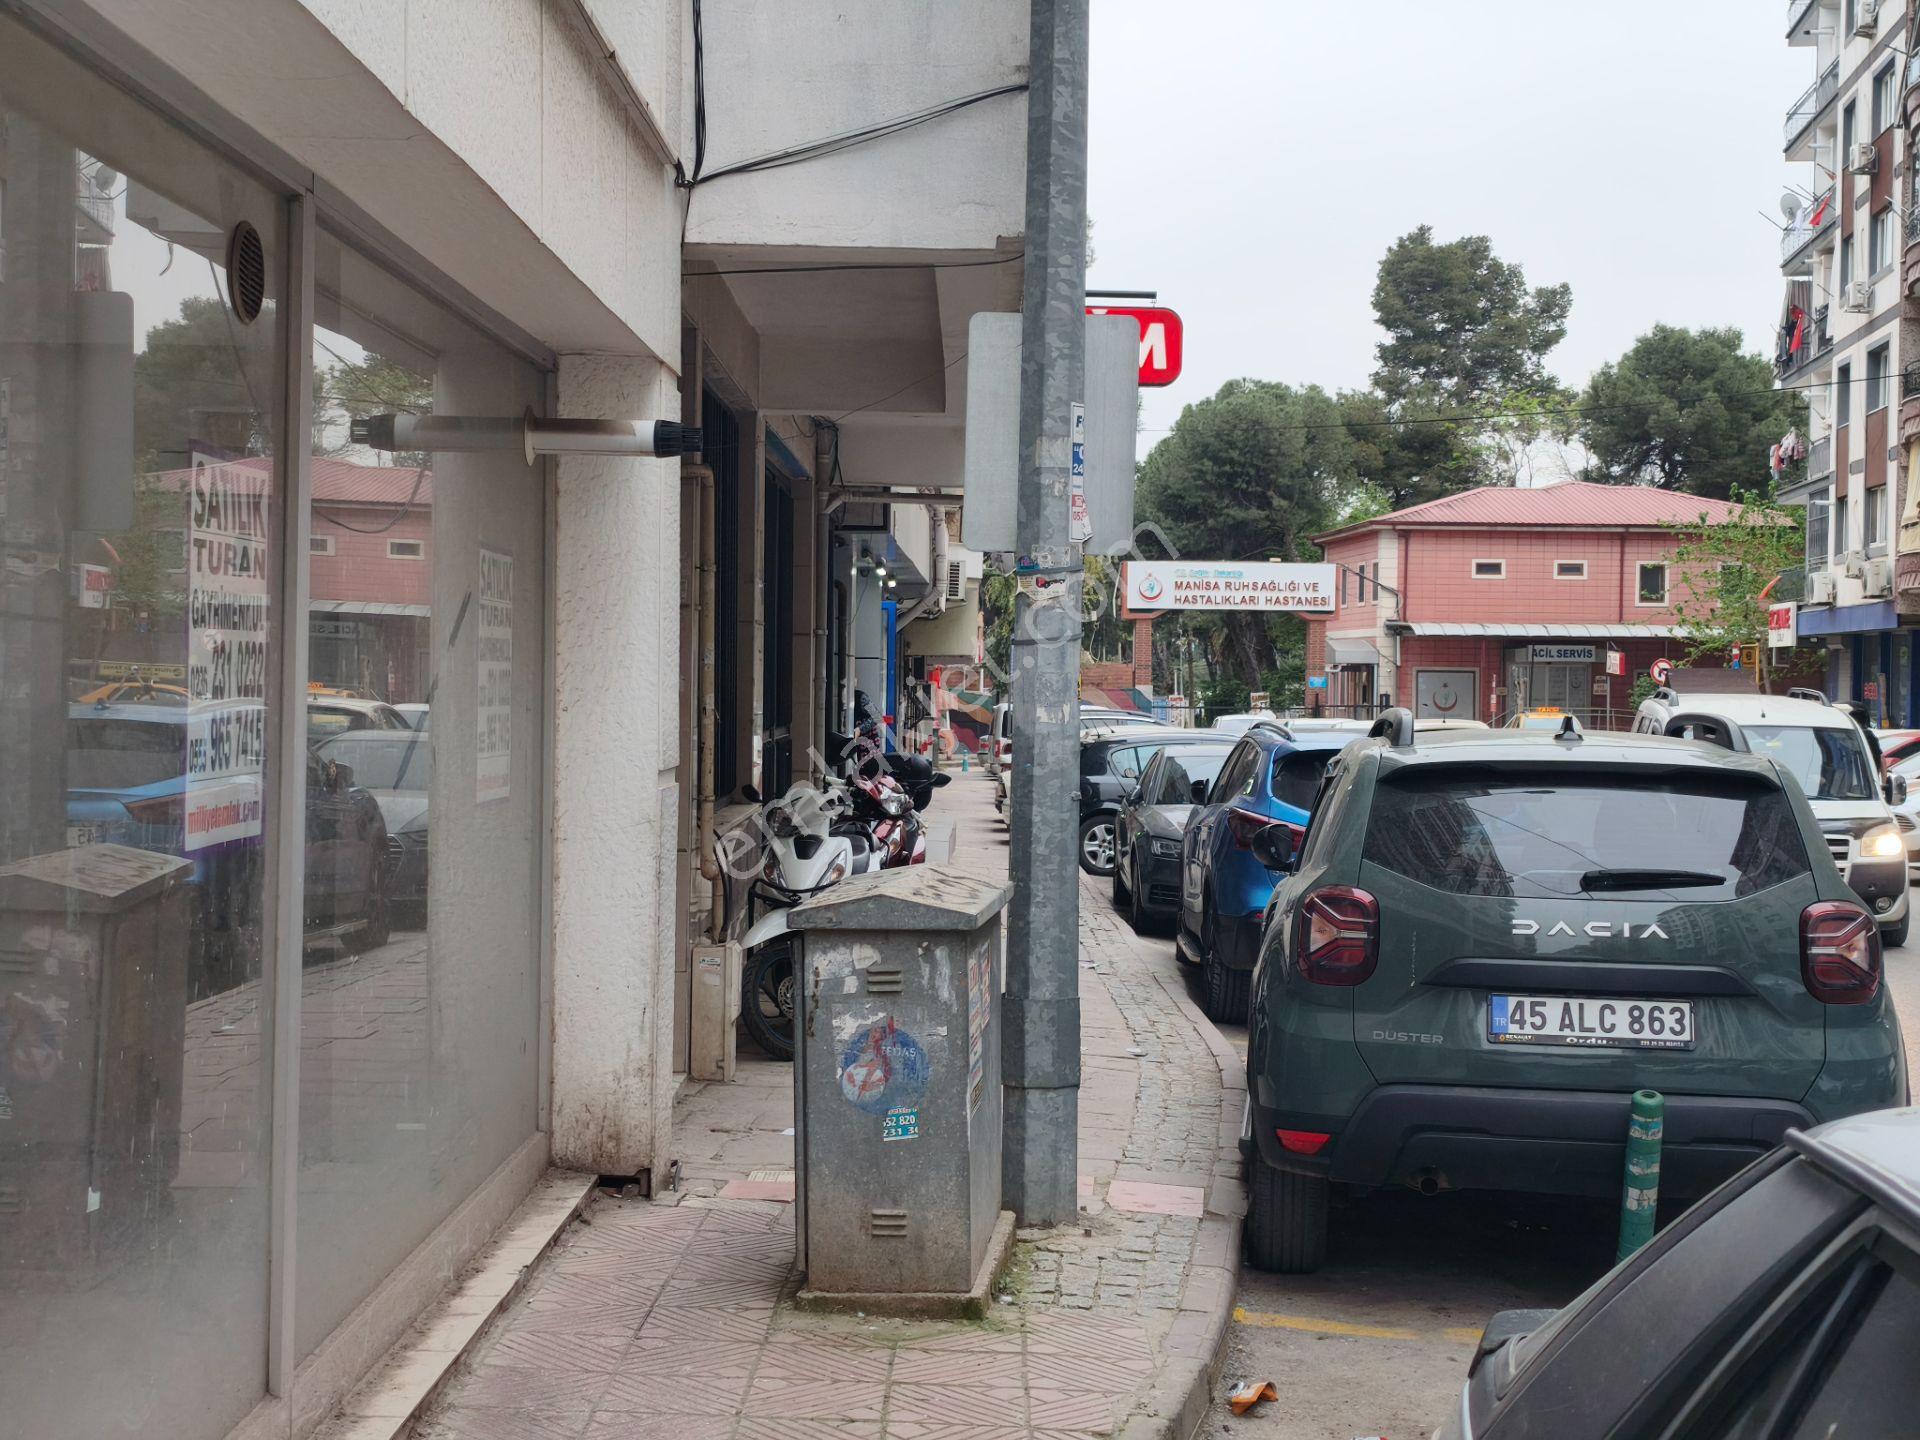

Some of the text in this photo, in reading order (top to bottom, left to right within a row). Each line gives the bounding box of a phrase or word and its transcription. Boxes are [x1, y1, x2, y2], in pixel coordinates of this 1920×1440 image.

[193, 460, 267, 539] SATILIK
[193, 537, 266, 580] TURAN
[1174, 579, 1220, 591] MANİSA
[1304, 582, 1319, 592] VE
[1174, 594, 1330, 606] HASTALIKLARI HASTANESİ
[1532, 647, 1593, 659] ACİL SERVİS
[211, 640, 232, 700] 231
[236, 640, 264, 698] 0232
[1512, 919, 1669, 939] DACIA
[1494, 1000, 1687, 1037] TR 45 ALC 863
[1372, 1030, 1444, 1044] DUSTER
[899, 1115, 916, 1125] 820
